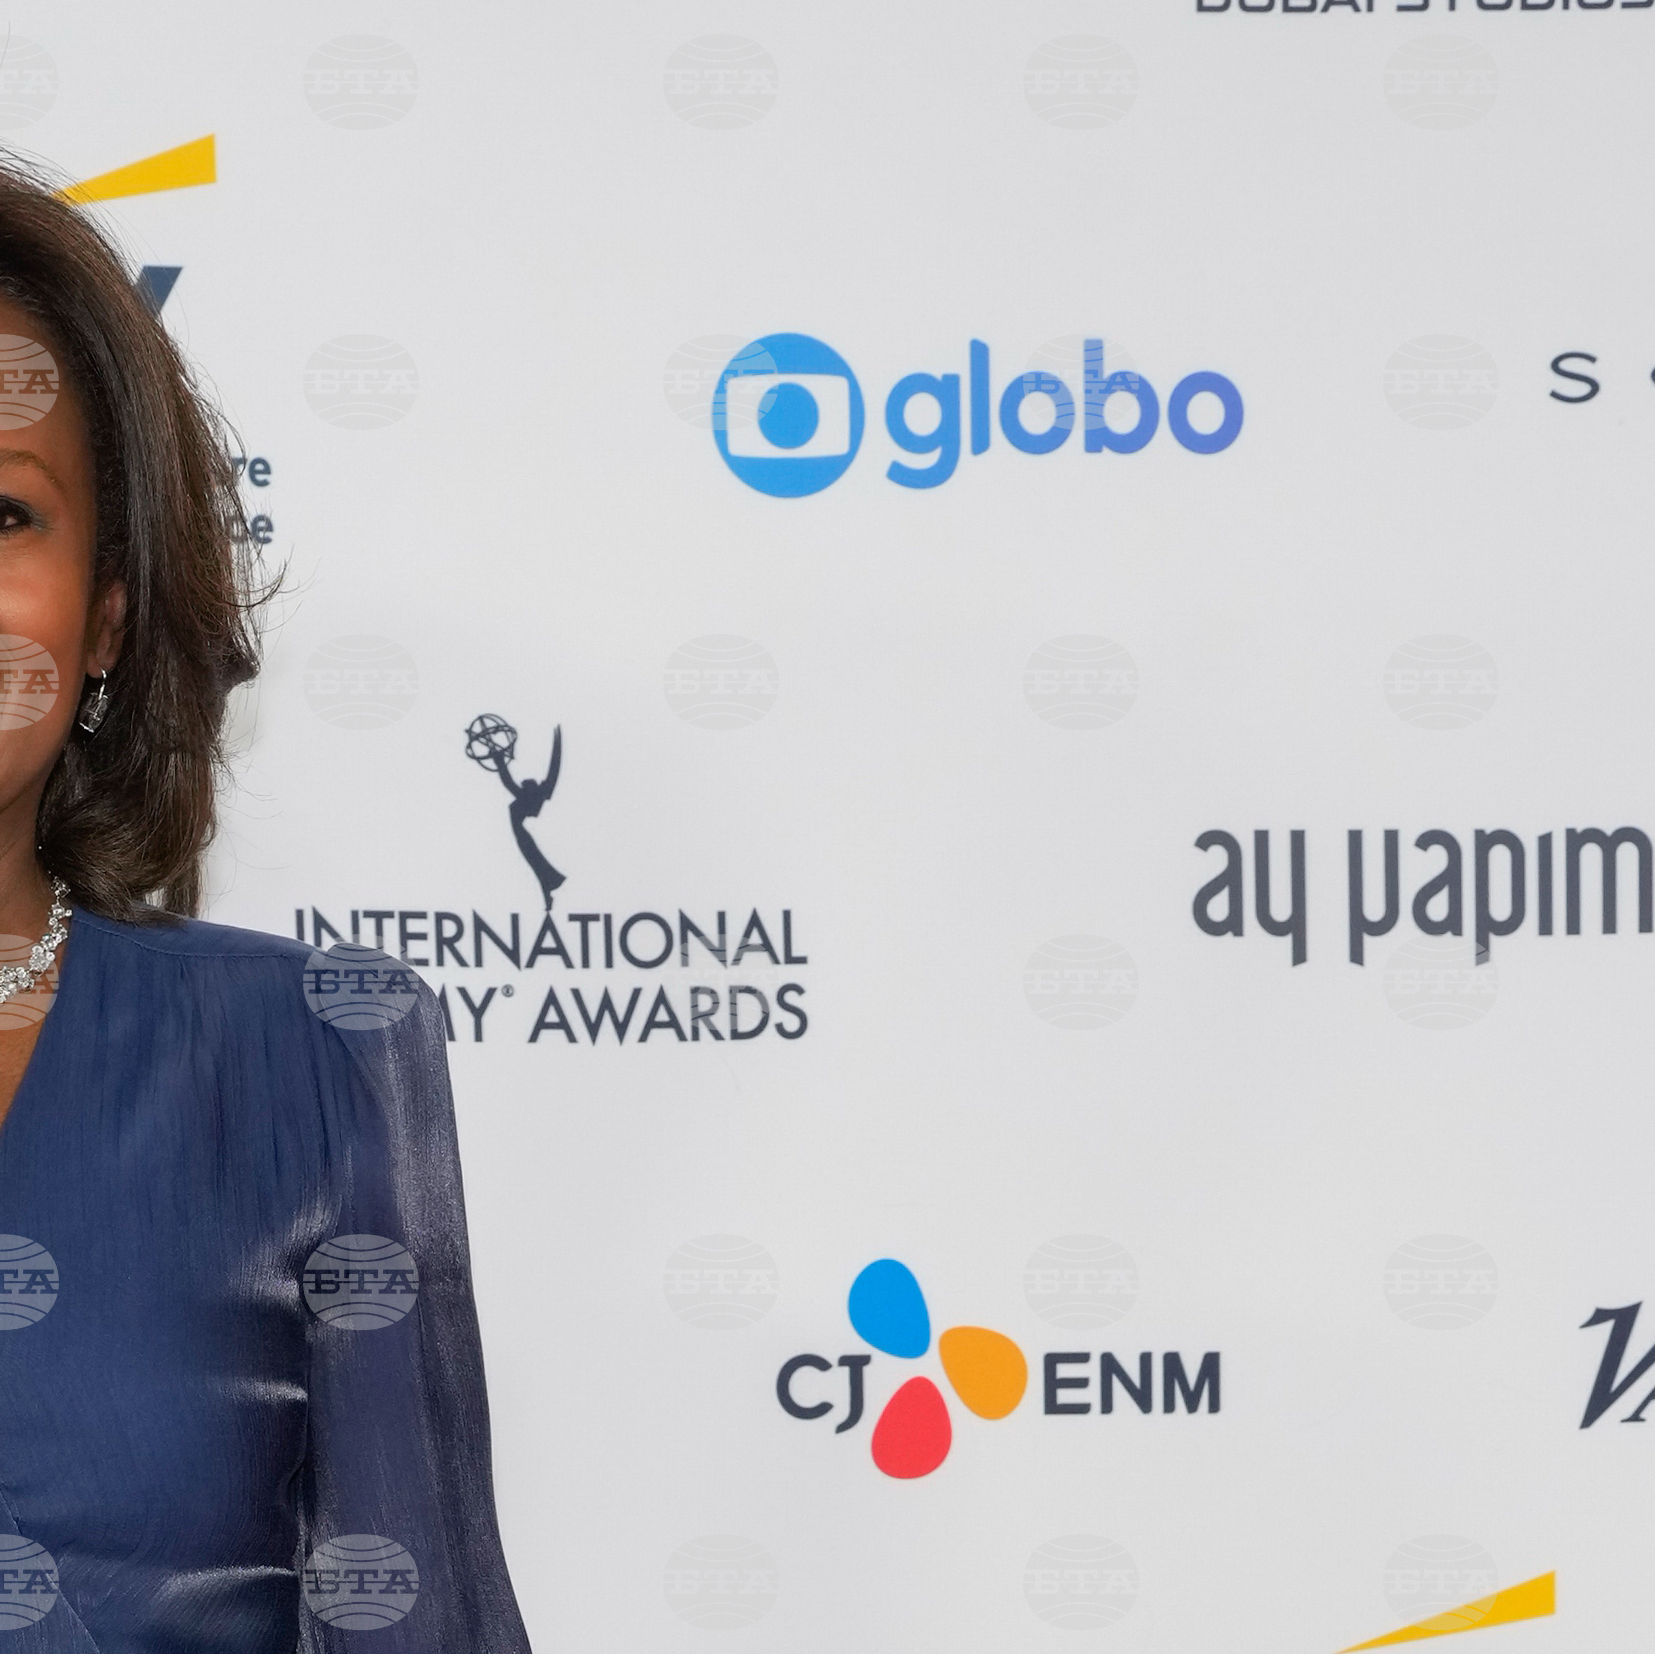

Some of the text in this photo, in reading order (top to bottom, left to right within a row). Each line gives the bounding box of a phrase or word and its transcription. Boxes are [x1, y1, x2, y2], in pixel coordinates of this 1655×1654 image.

[884, 338, 1245, 491] globo
[528, 983, 809, 1046] AWARDS
[775, 1350, 1222, 1435] CJ ENM
